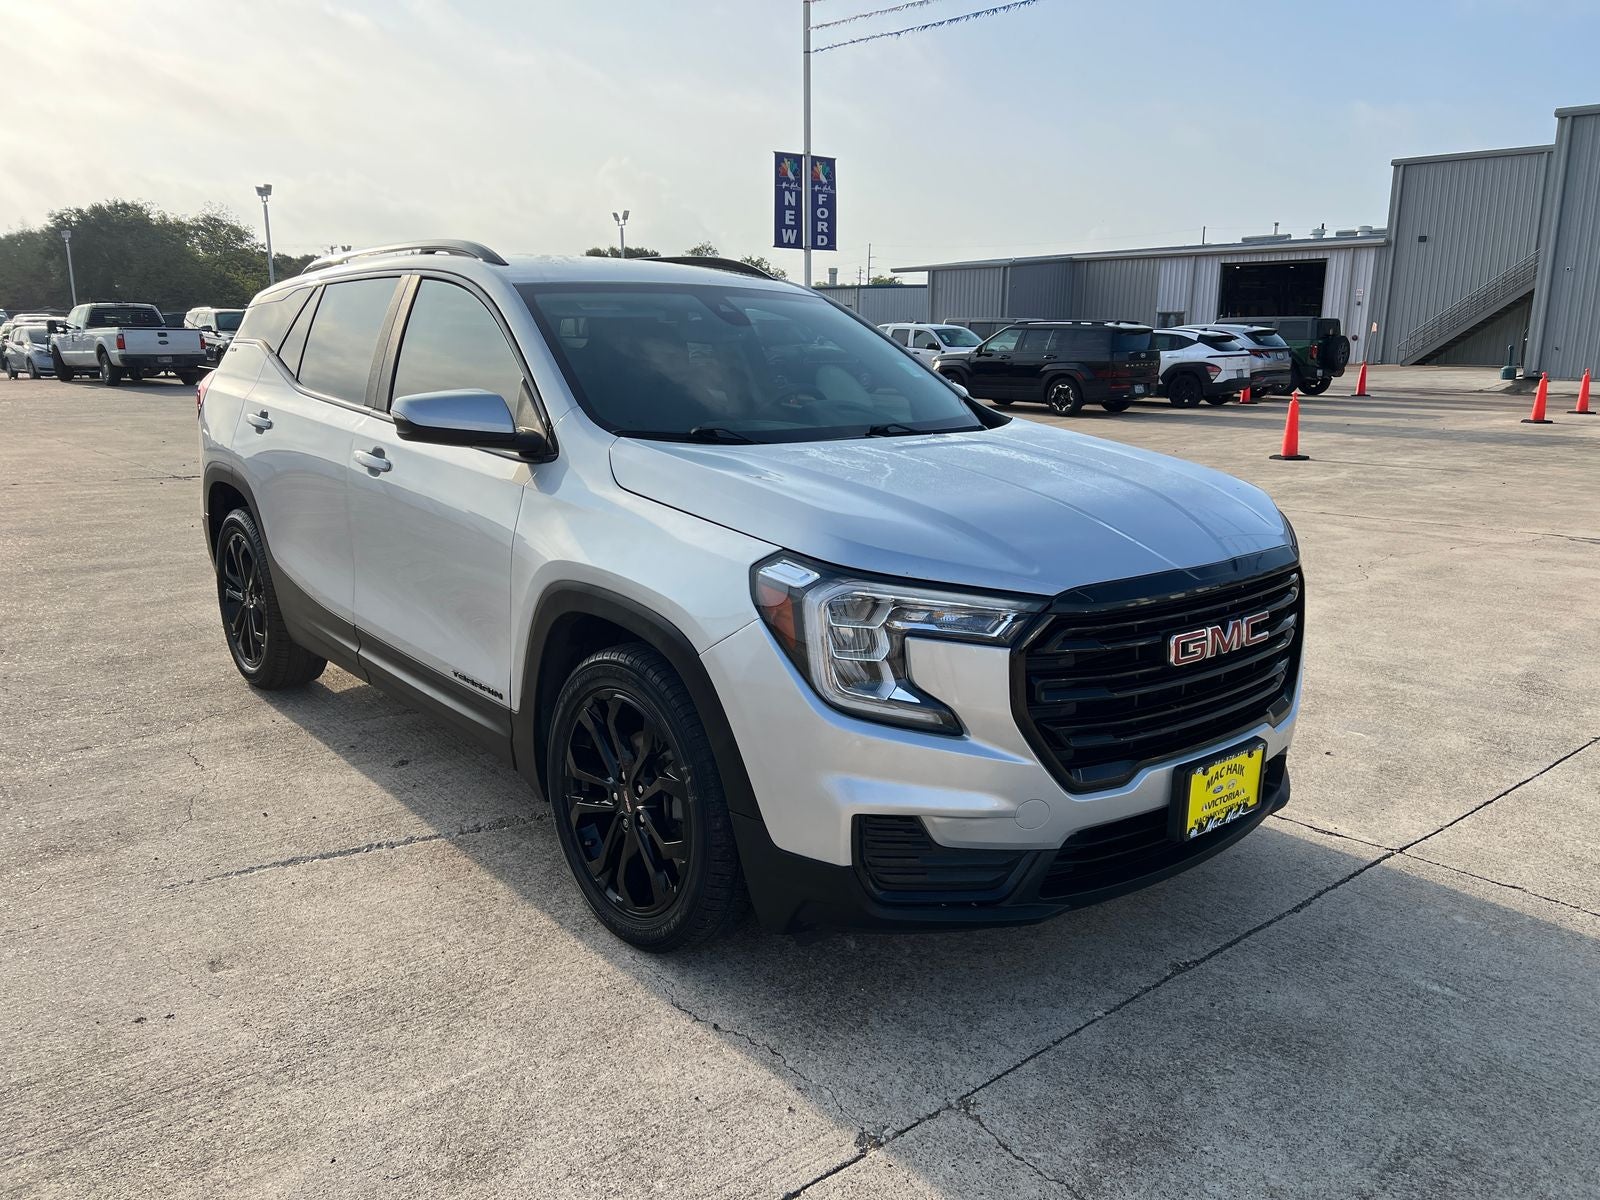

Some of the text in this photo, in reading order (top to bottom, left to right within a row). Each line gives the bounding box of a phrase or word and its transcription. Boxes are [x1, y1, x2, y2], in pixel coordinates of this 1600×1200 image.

[782, 191, 797, 244] NEW
[817, 194, 828, 246] FORD
[1170, 611, 1270, 667] GMC
[1206, 766, 1225, 792] MAC
[1226, 763, 1245, 777] HAIK
[1207, 789, 1240, 810] VICTORIA
